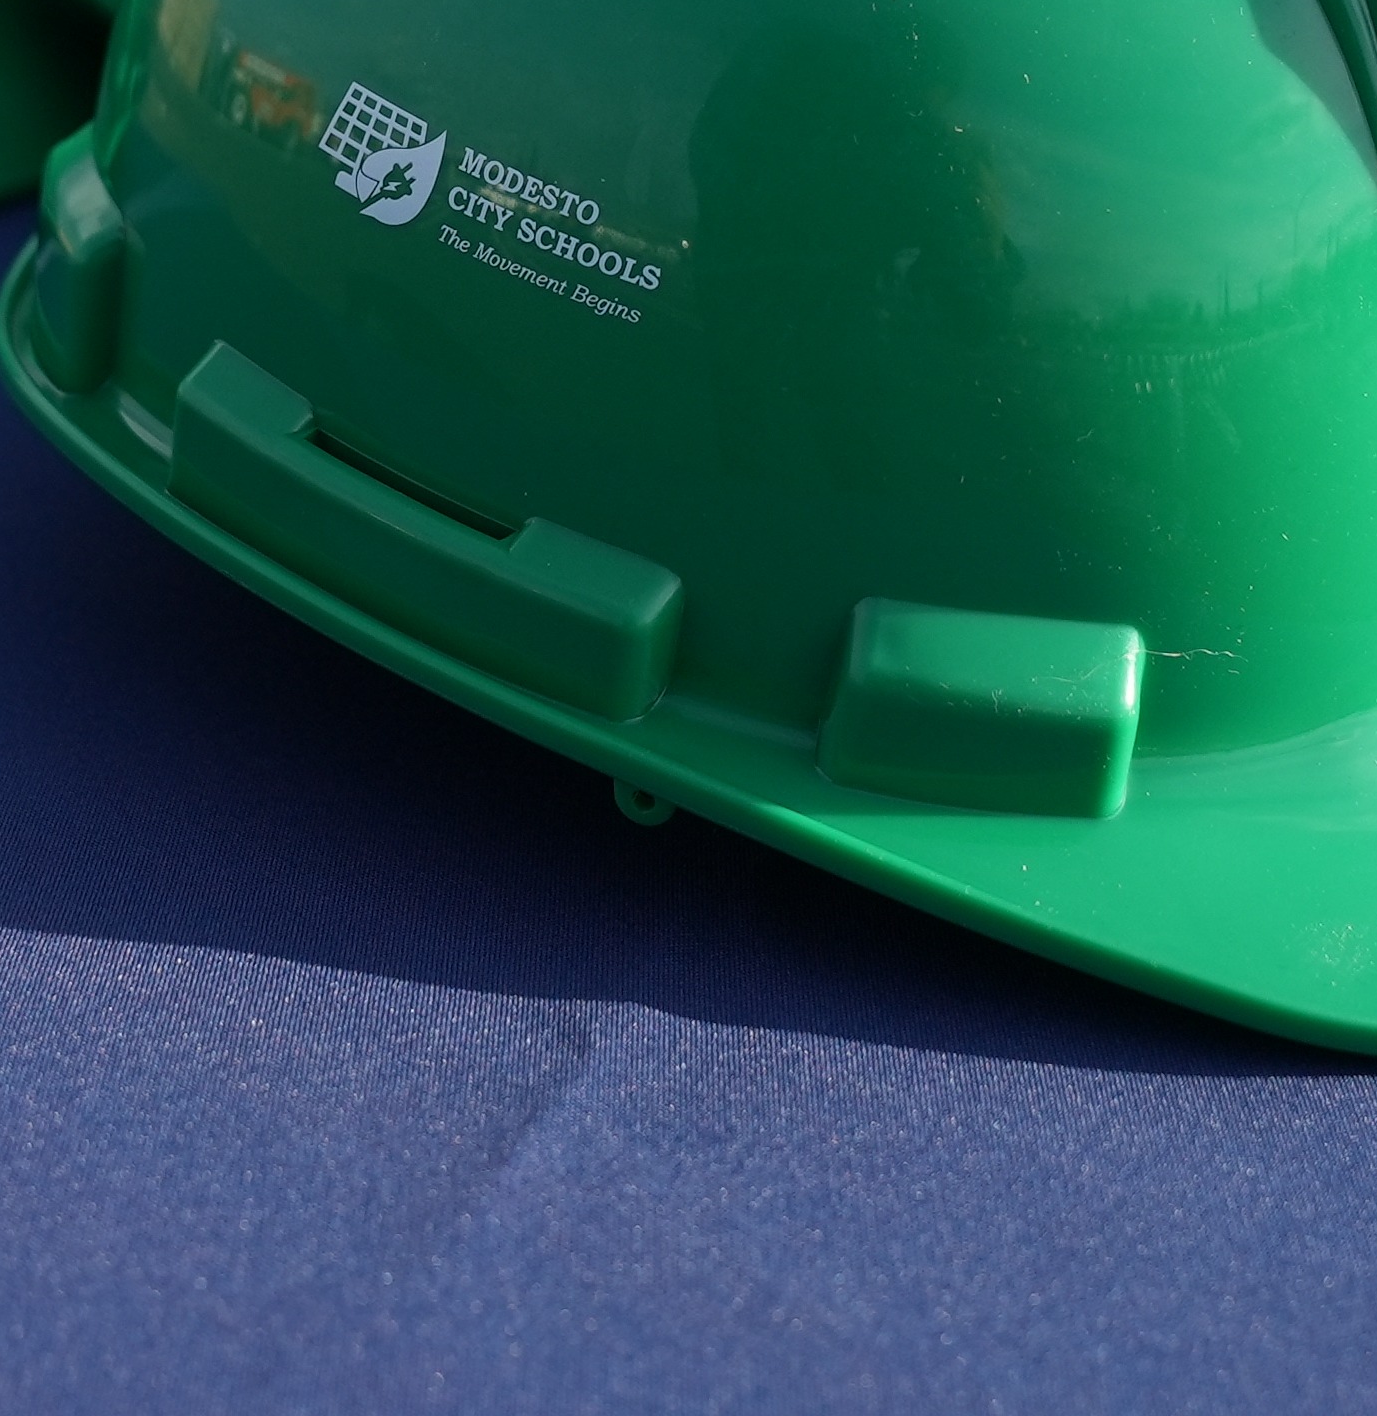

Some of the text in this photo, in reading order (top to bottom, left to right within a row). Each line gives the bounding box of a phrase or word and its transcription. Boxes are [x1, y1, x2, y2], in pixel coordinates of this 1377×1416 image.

[457, 146, 600, 226] MODESTO
[438, 225, 641, 323] The Movement Begins
[447, 186, 662, 291] CITY SCHOOLS
